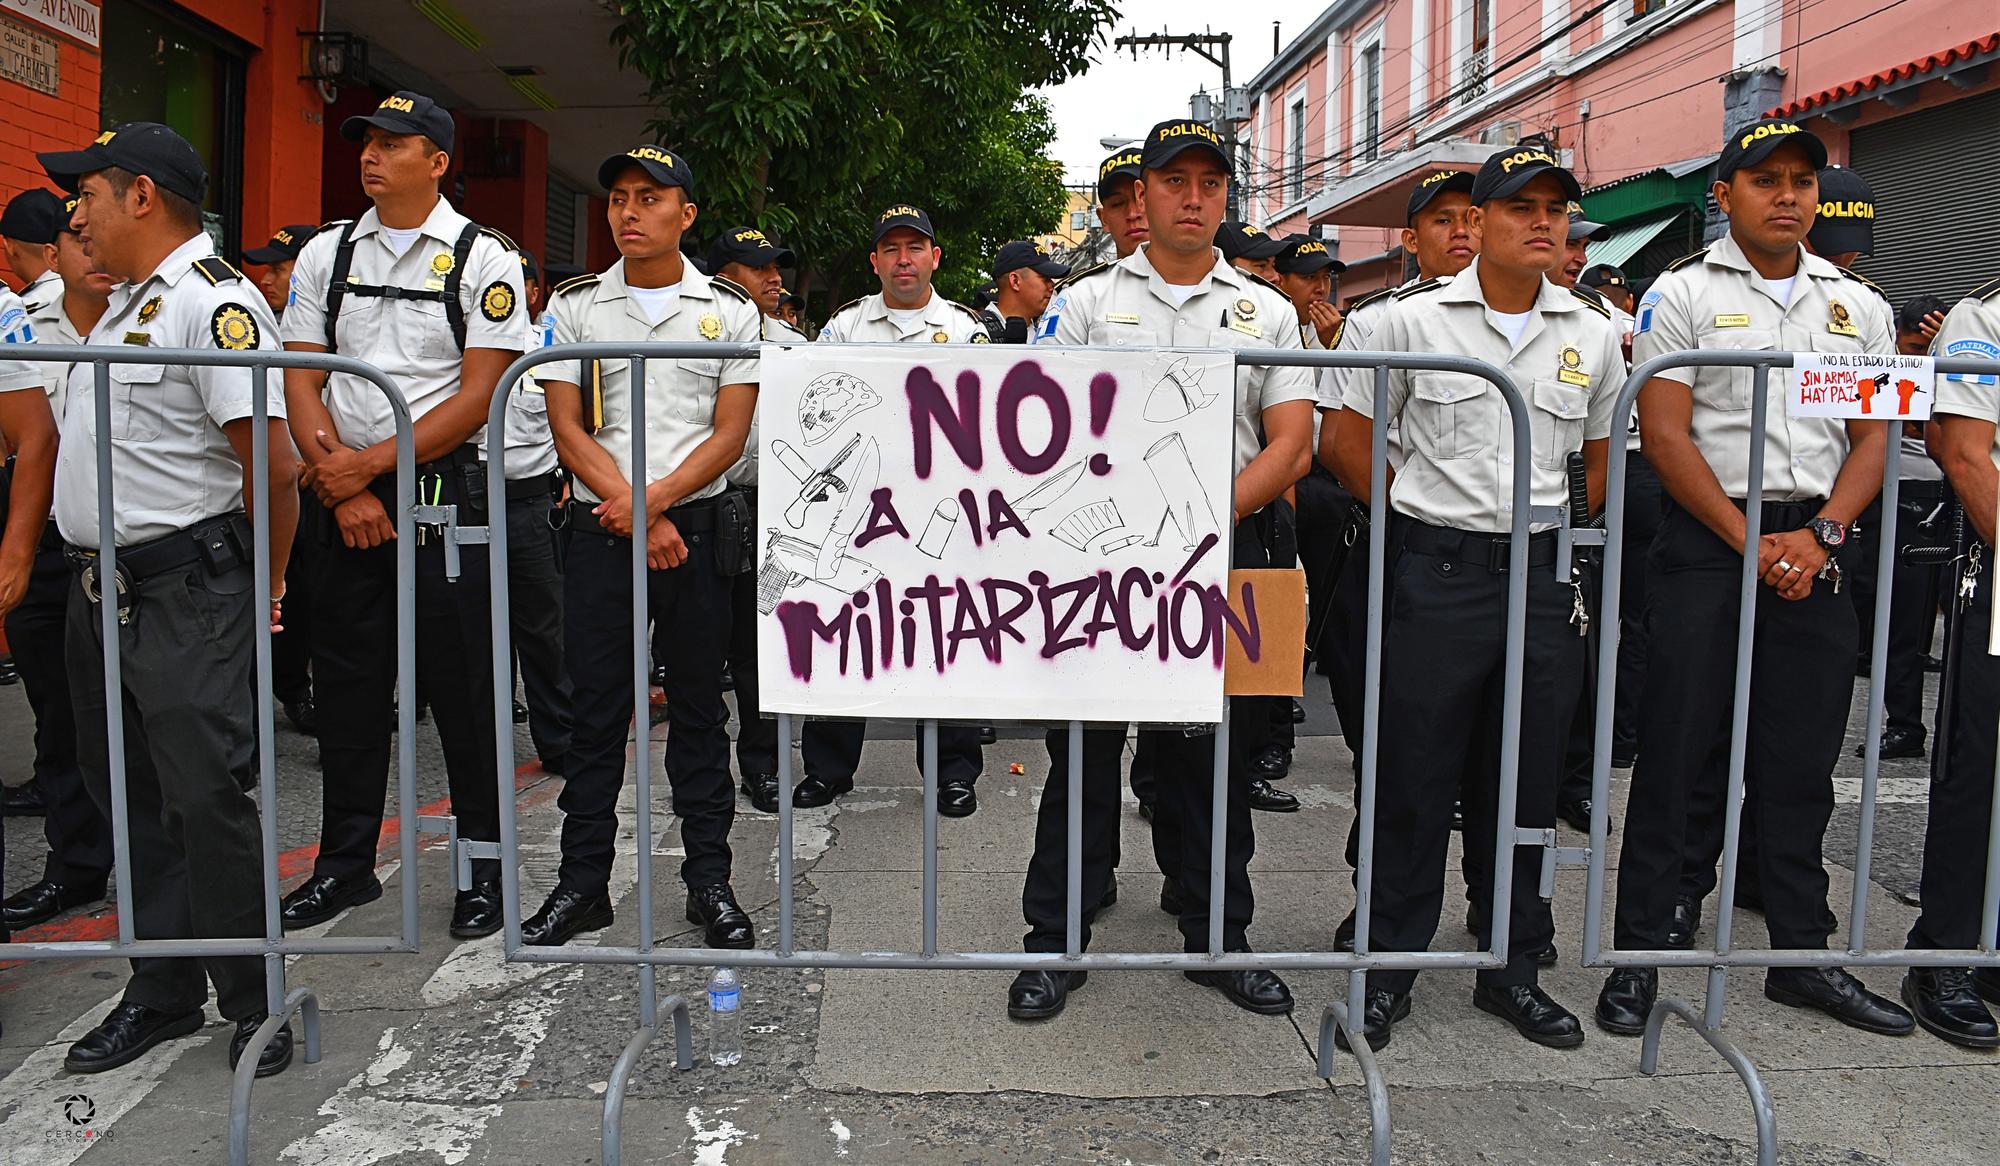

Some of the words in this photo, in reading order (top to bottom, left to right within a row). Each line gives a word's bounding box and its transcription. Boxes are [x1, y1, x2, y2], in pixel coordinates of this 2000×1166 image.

[40, 0, 97, 39] AVENIDA
[4, 32, 26, 48] CALLE
[31, 42, 42, 55] DEL
[14, 53, 50, 86] CARMEN
[1159, 123, 1219, 146] POLICIA
[627, 148, 673, 168] LICIA
[1100, 154, 1142, 180] POLIC
[880, 206, 920, 224] POLICIA
[1840, 355, 1850, 367] AL
[1852, 355, 1884, 368] ESTADO
[1886, 357, 1897, 369] DE
[1900, 357, 1923, 369] SITIO!
[1801, 370, 1821, 387] SIN
[1824, 370, 1858, 385] ARMAS
[1801, 386, 1828, 404] HAY
[1830, 385, 1858, 404] PAZ
[905, 359, 1118, 480] NO!
[855, 487, 910, 549] A
